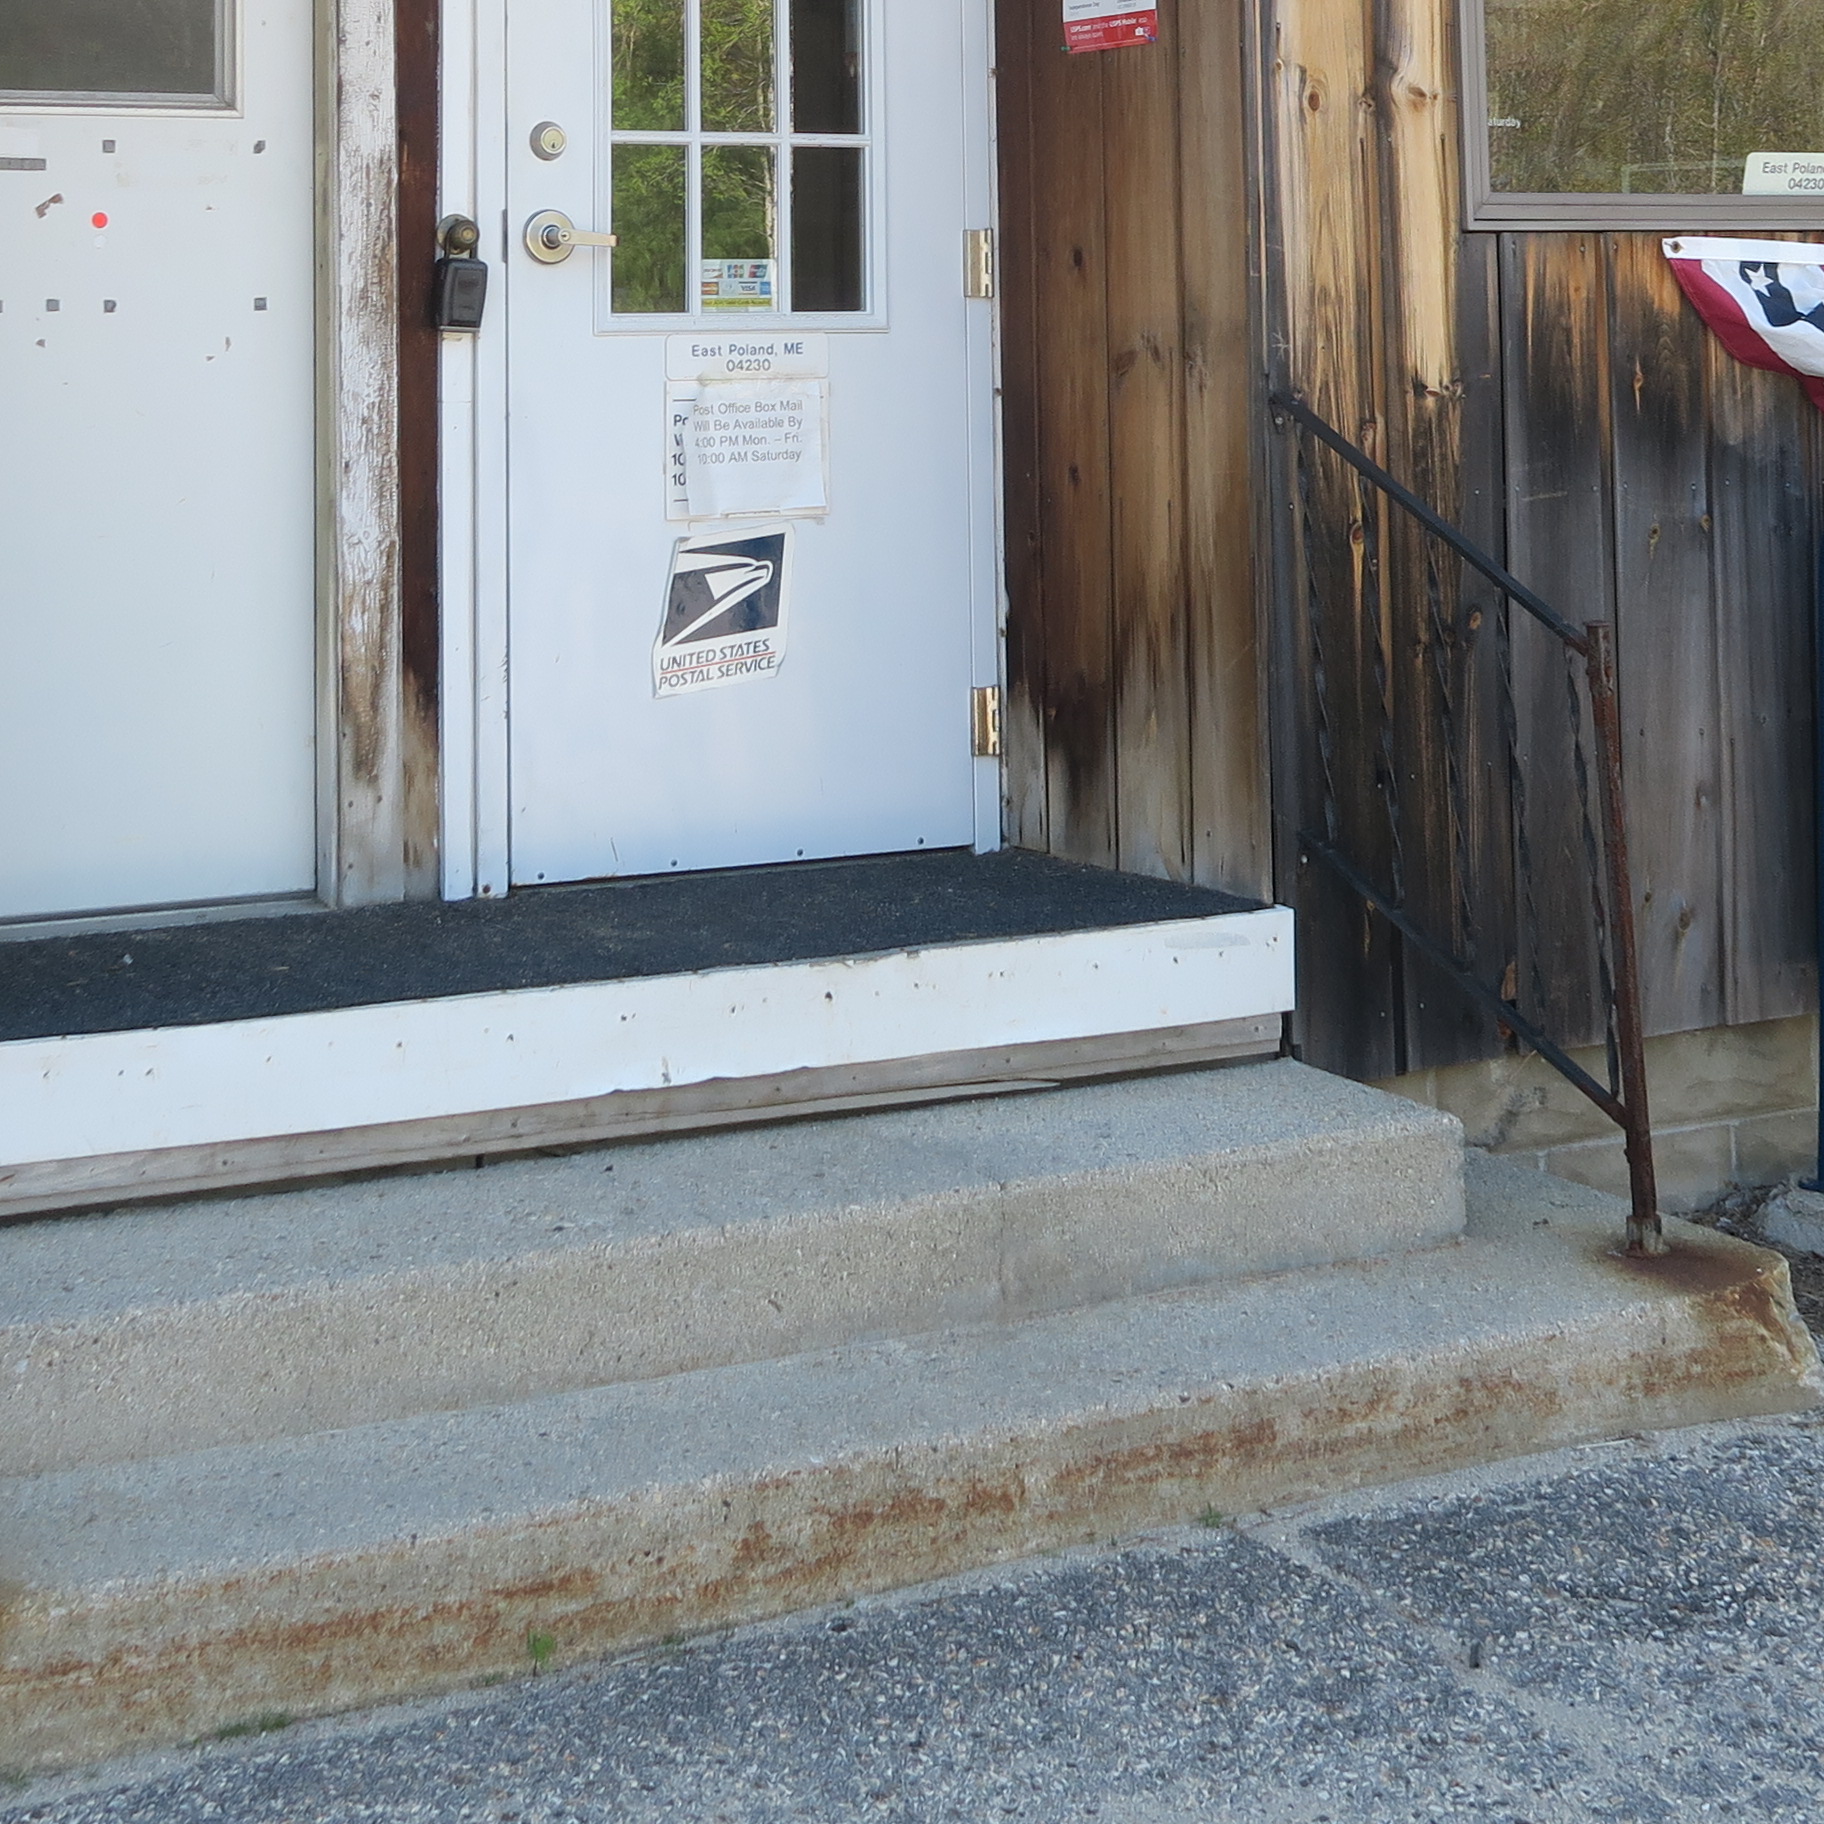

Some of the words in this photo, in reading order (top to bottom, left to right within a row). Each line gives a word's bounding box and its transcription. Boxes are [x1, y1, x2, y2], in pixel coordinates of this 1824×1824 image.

[1487, 116, 1521, 129] aturday
[1762, 161, 1788, 174] East
[691, 343, 723, 358] East
[728, 343, 778, 357] Poland,
[784, 342, 804, 355] ME
[726, 358, 772, 373] 04230
[693, 404, 715, 416] Post
[718, 401, 752, 414] Office
[754, 401, 777, 413] Box
[779, 399, 803, 412] Mail
[693, 420, 711, 433] Will
[714, 419, 730, 432] Be
[733, 417, 785, 431] Available
[788, 416, 803, 430] By
[719, 435, 739, 448] PM
[742, 434, 771, 446] Mon.
[728, 450, 748, 464] AM
[751, 448, 802, 463] Saturday
[659, 648, 717, 672] UNITED
[718, 637, 771, 661] STATES
[658, 667, 715, 691] POSTAL
[716, 654, 777, 679] SERVICE
